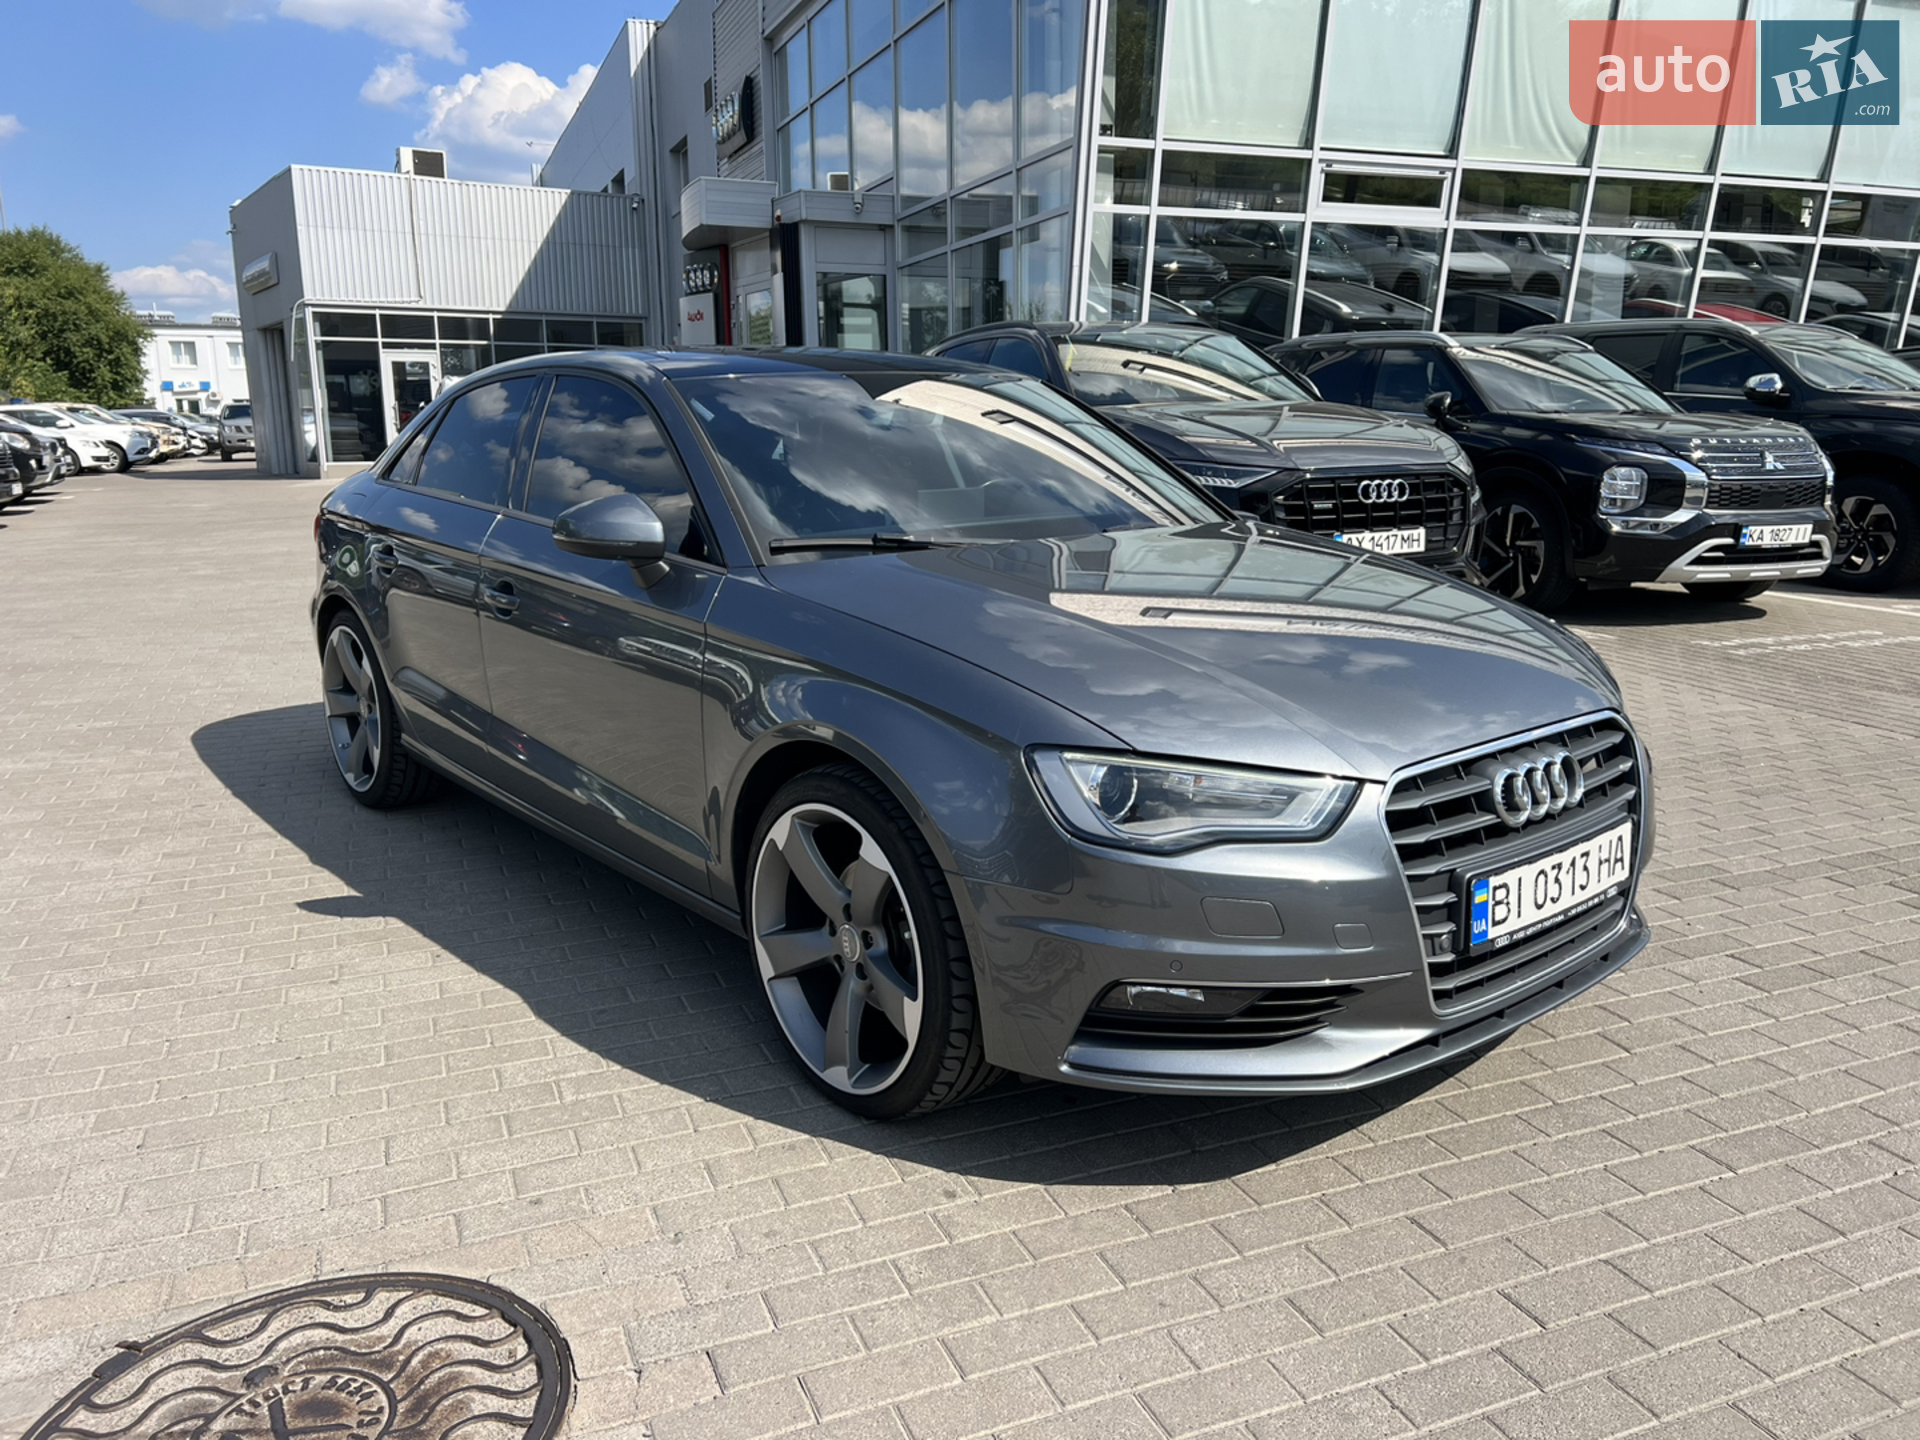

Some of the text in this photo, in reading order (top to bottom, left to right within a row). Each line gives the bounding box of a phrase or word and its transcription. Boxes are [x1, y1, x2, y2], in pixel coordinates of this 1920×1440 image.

[1368, 533, 1399, 551] 1417
[1400, 532, 1421, 550] MH
[1747, 528, 1765, 543] KA
[1768, 527, 1793, 542] 1827
[1491, 875, 1523, 928] BI
[1533, 848, 1592, 911] 0313
[1596, 833, 1626, 885] HA
[1473, 918, 1488, 934] UA
